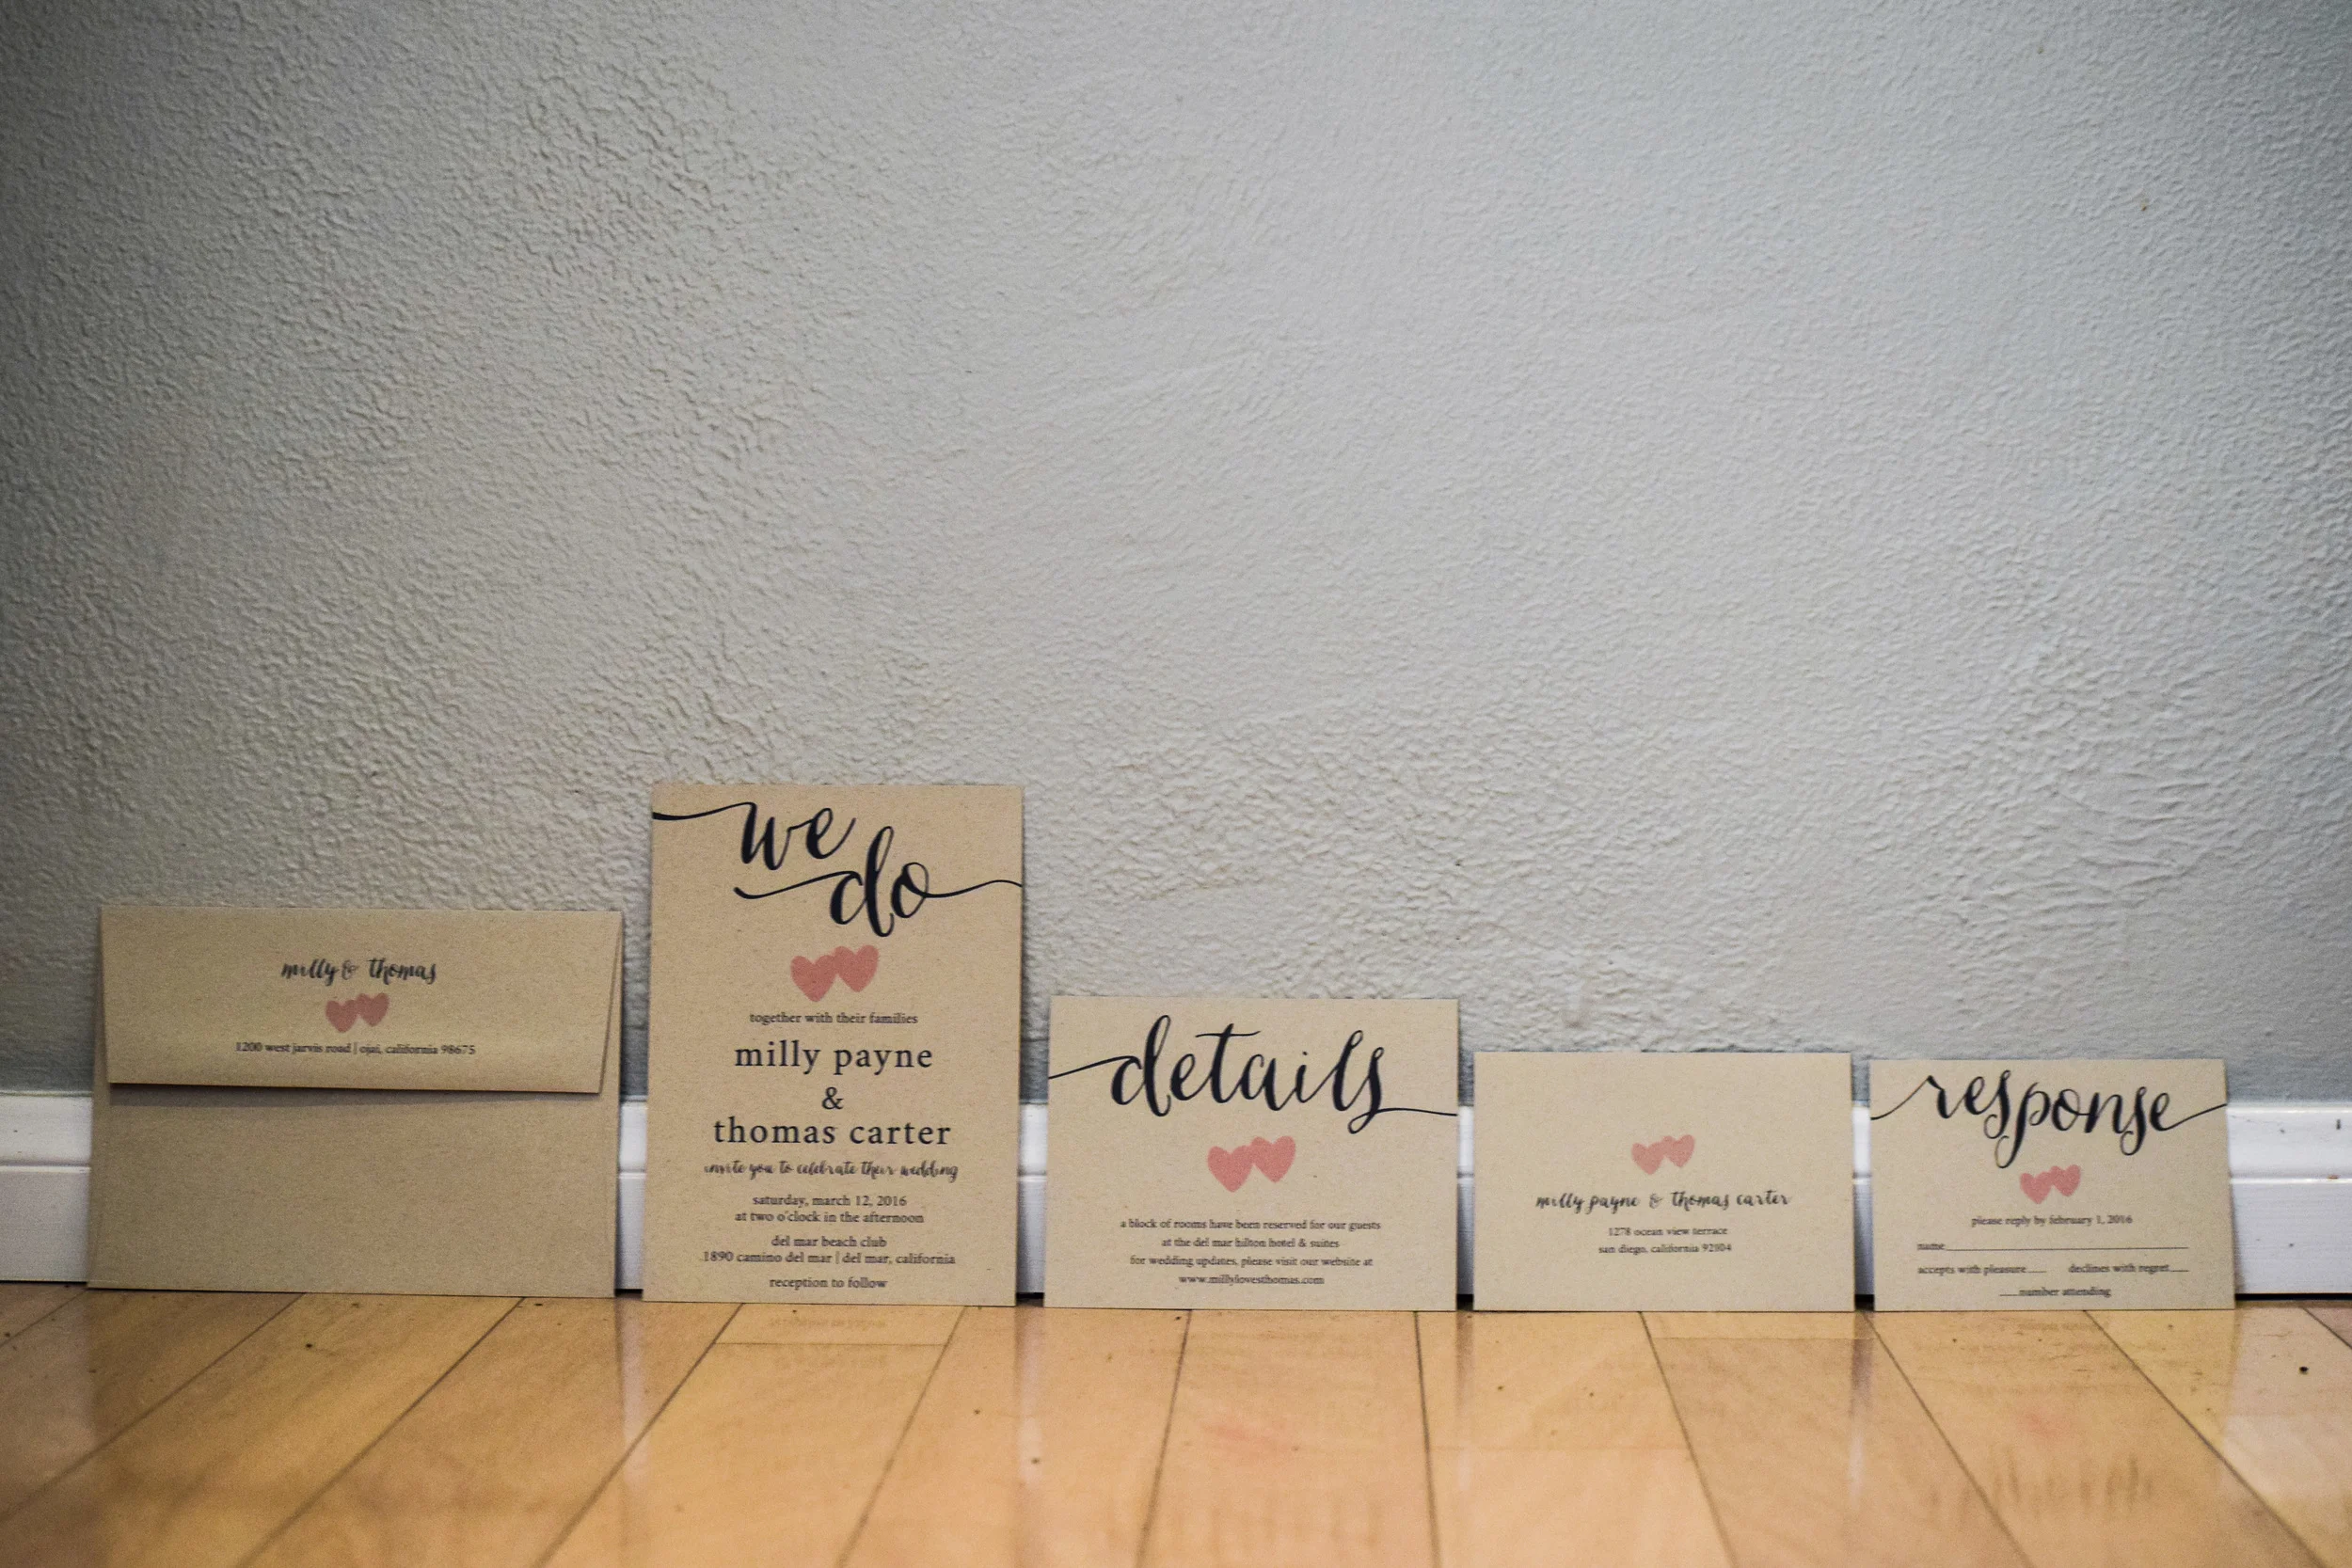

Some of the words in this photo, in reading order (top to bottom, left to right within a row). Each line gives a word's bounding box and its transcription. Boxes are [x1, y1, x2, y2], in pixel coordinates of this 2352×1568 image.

[652, 801, 857, 871] we
[281, 958, 336, 986] milly
[342, 959, 358, 980] &
[367, 958, 437, 985] thomas
[750, 1012, 802, 1024] together
[804, 1012, 834, 1023] with
[836, 1012, 866, 1023] their
[869, 1012, 918, 1024] families
[236, 1042, 262, 1052] 1200
[292, 1043, 323, 1053] jarvis
[326, 1043, 351, 1053] road
[385, 1044, 438, 1053] california
[440, 1045, 475, 1053] 98675
[734, 1039, 821, 1075] milly
[834, 1048, 933, 1076] payne
[1048, 1014, 1458, 1134] details
[820, 1086, 845, 1111] &
[1870, 1069, 2227, 1168] response
[713, 1116, 836, 1145] thomas
[849, 1120, 951, 1145] carter
[704, 1161, 748, 1175] invite
[749, 1164, 773, 1180] you
[778, 1161, 795, 1175] to
[796, 1160, 857, 1175] celebrate
[860, 1161, 895, 1180] their
[899, 1160, 959, 1183] wedding
[753, 1194, 809, 1209] saturday,
[812, 1195, 852, 1206] march
[855, 1196, 873, 1208] 12,
[876, 1195, 907, 1207] 2016
[1535, 1191, 1584, 1213] milly
[1584, 1196, 1640, 1214] payne
[1648, 1193, 1662, 1208] &
[1670, 1190, 1730, 1212] thomas
[1736, 1189, 1788, 1207] carter
[735, 1212, 748, 1222] at
[750, 1212, 775, 1222] two
[823, 1212, 837, 1223] in
[839, 1212, 860, 1223] the
[862, 1212, 924, 1224] afternoon
[1128, 1218, 1157, 1228] block
[1159, 1219, 1172, 1228] of
[1209, 1219, 1232, 1228] have
[1235, 1219, 1261, 1229] been
[1263, 1219, 1307, 1229] reserved
[1310, 1219, 1326, 1229] for
[1348, 1221, 1382, 1231] guests
[1971, 1215, 2003, 1227] please
[2005, 1215, 2031, 1227] reply
[2033, 1215, 2046, 1227] by
[2048, 1214, 2092, 1227] february
[2106, 1214, 2133, 1224] 2016
[1608, 1227, 1631, 1236] 1278
[1666, 1227, 1690, 1235] view
[771, 1235, 791, 1247] del
[793, 1238, 818, 1247] mar
[820, 1235, 857, 1248] beach
[860, 1236, 887, 1248] club
[1173, 1238, 1192, 1247] the
[1193, 1237, 1209, 1247] del
[1211, 1239, 1232, 1247] mar
[1234, 1238, 1267, 1247] hilton
[1268, 1238, 1295, 1247] hotel
[1297, 1239, 1307, 1247] &
[1310, 1239, 1340, 1248] suites
[1650, 1243, 1700, 1253] california
[1916, 1242, 1947, 1251] name
[702, 1251, 734, 1262] 1890
[737, 1252, 783, 1263] camino
[785, 1251, 805, 1263] del
[808, 1254, 834, 1263] mar
[841, 1252, 862, 1264] del
[896, 1252, 956, 1265] california
[1130, 1255, 1146, 1265] for
[1149, 1255, 1194, 1267] wedding
[1241, 1257, 1273, 1268] please
[1275, 1257, 1298, 1266] visit
[1321, 1257, 1361, 1266] website
[1362, 1258, 1374, 1266] at
[1917, 1264, 1955, 1275] accepts
[1957, 1263, 1980, 1275] with
[1983, 1263, 2026, 1276] pleasure
[2068, 1263, 2110, 1274] declines
[2112, 1263, 2137, 1273] with
[2138, 1263, 2169, 1275] regret
[769, 1276, 829, 1291] reception
[832, 1278, 845, 1289] to
[847, 1276, 888, 1289] follow
[1179, 1274, 1325, 1286] www.millylovesthomas.com
[2019, 1287, 2059, 1297] number
[2062, 1286, 2111, 1298] attending
